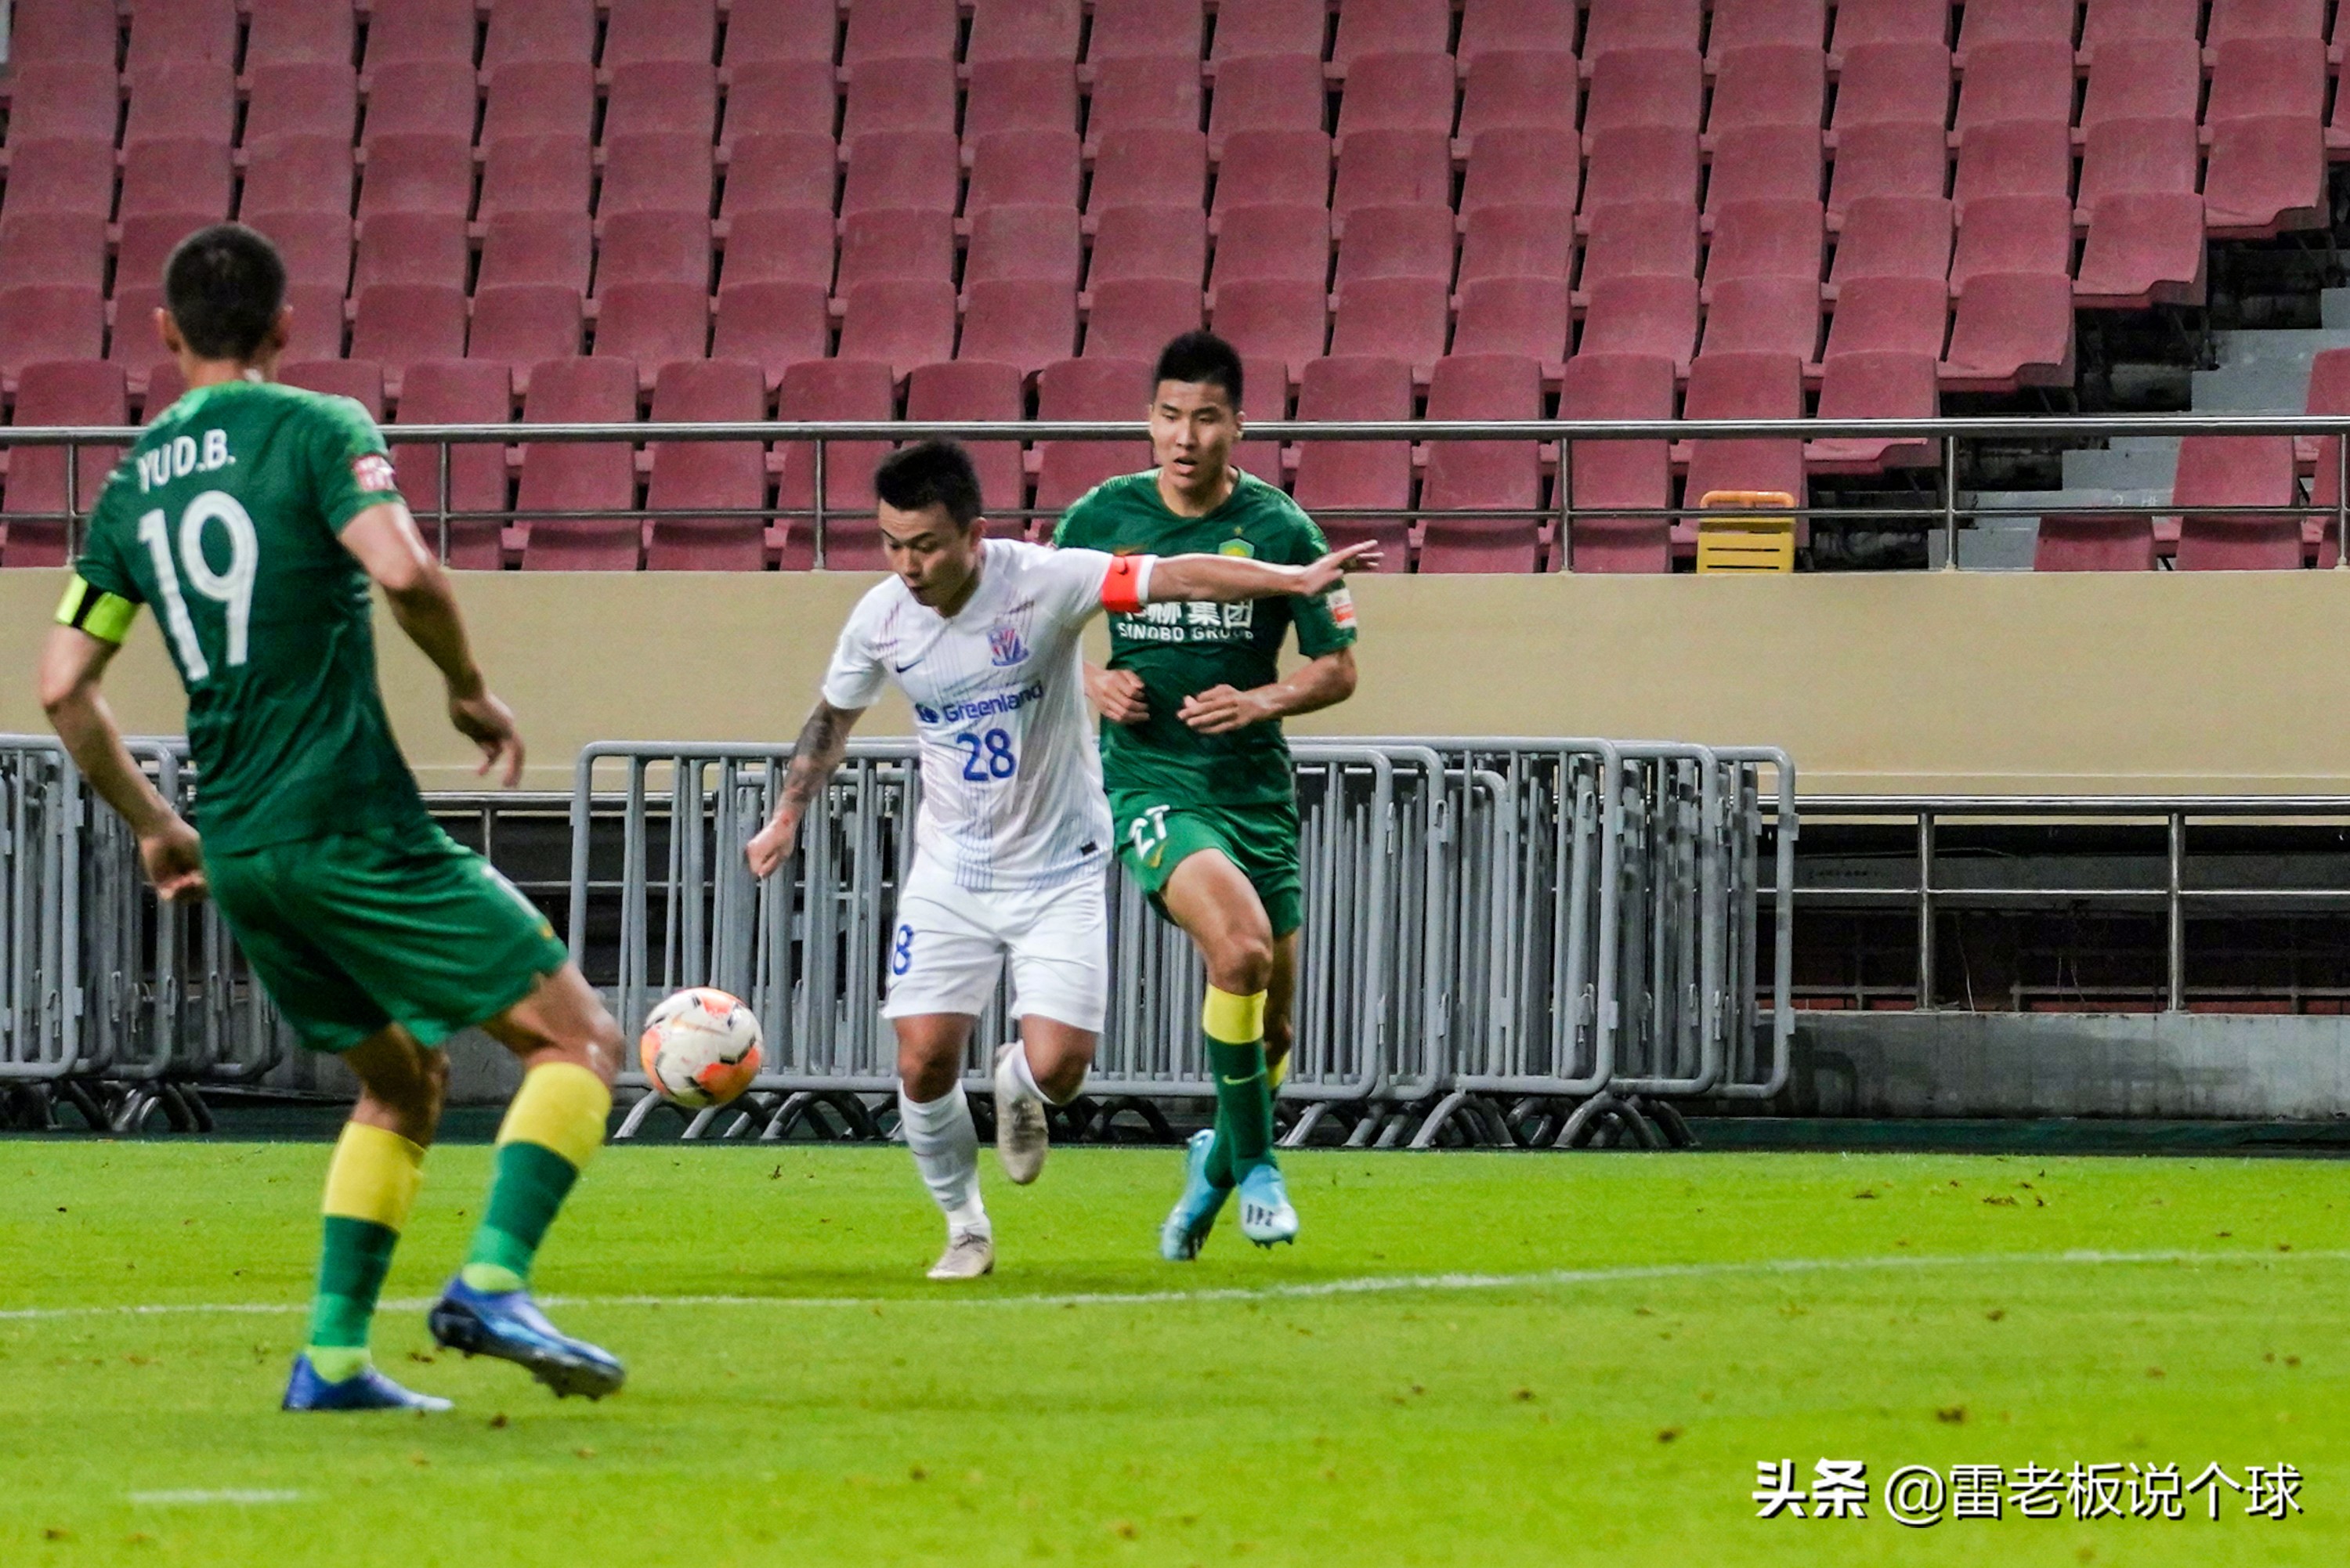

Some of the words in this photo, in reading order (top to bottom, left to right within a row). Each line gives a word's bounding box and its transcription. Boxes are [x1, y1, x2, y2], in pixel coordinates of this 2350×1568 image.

[137, 490, 259, 681] 19
[1117, 622, 1184, 641] SINOBO
[1125, 599, 1253, 628] 赫集团
[942, 679, 1045, 723] Greenland
[956, 728, 1017, 782] 28
[1128, 804, 1171, 860] 27
